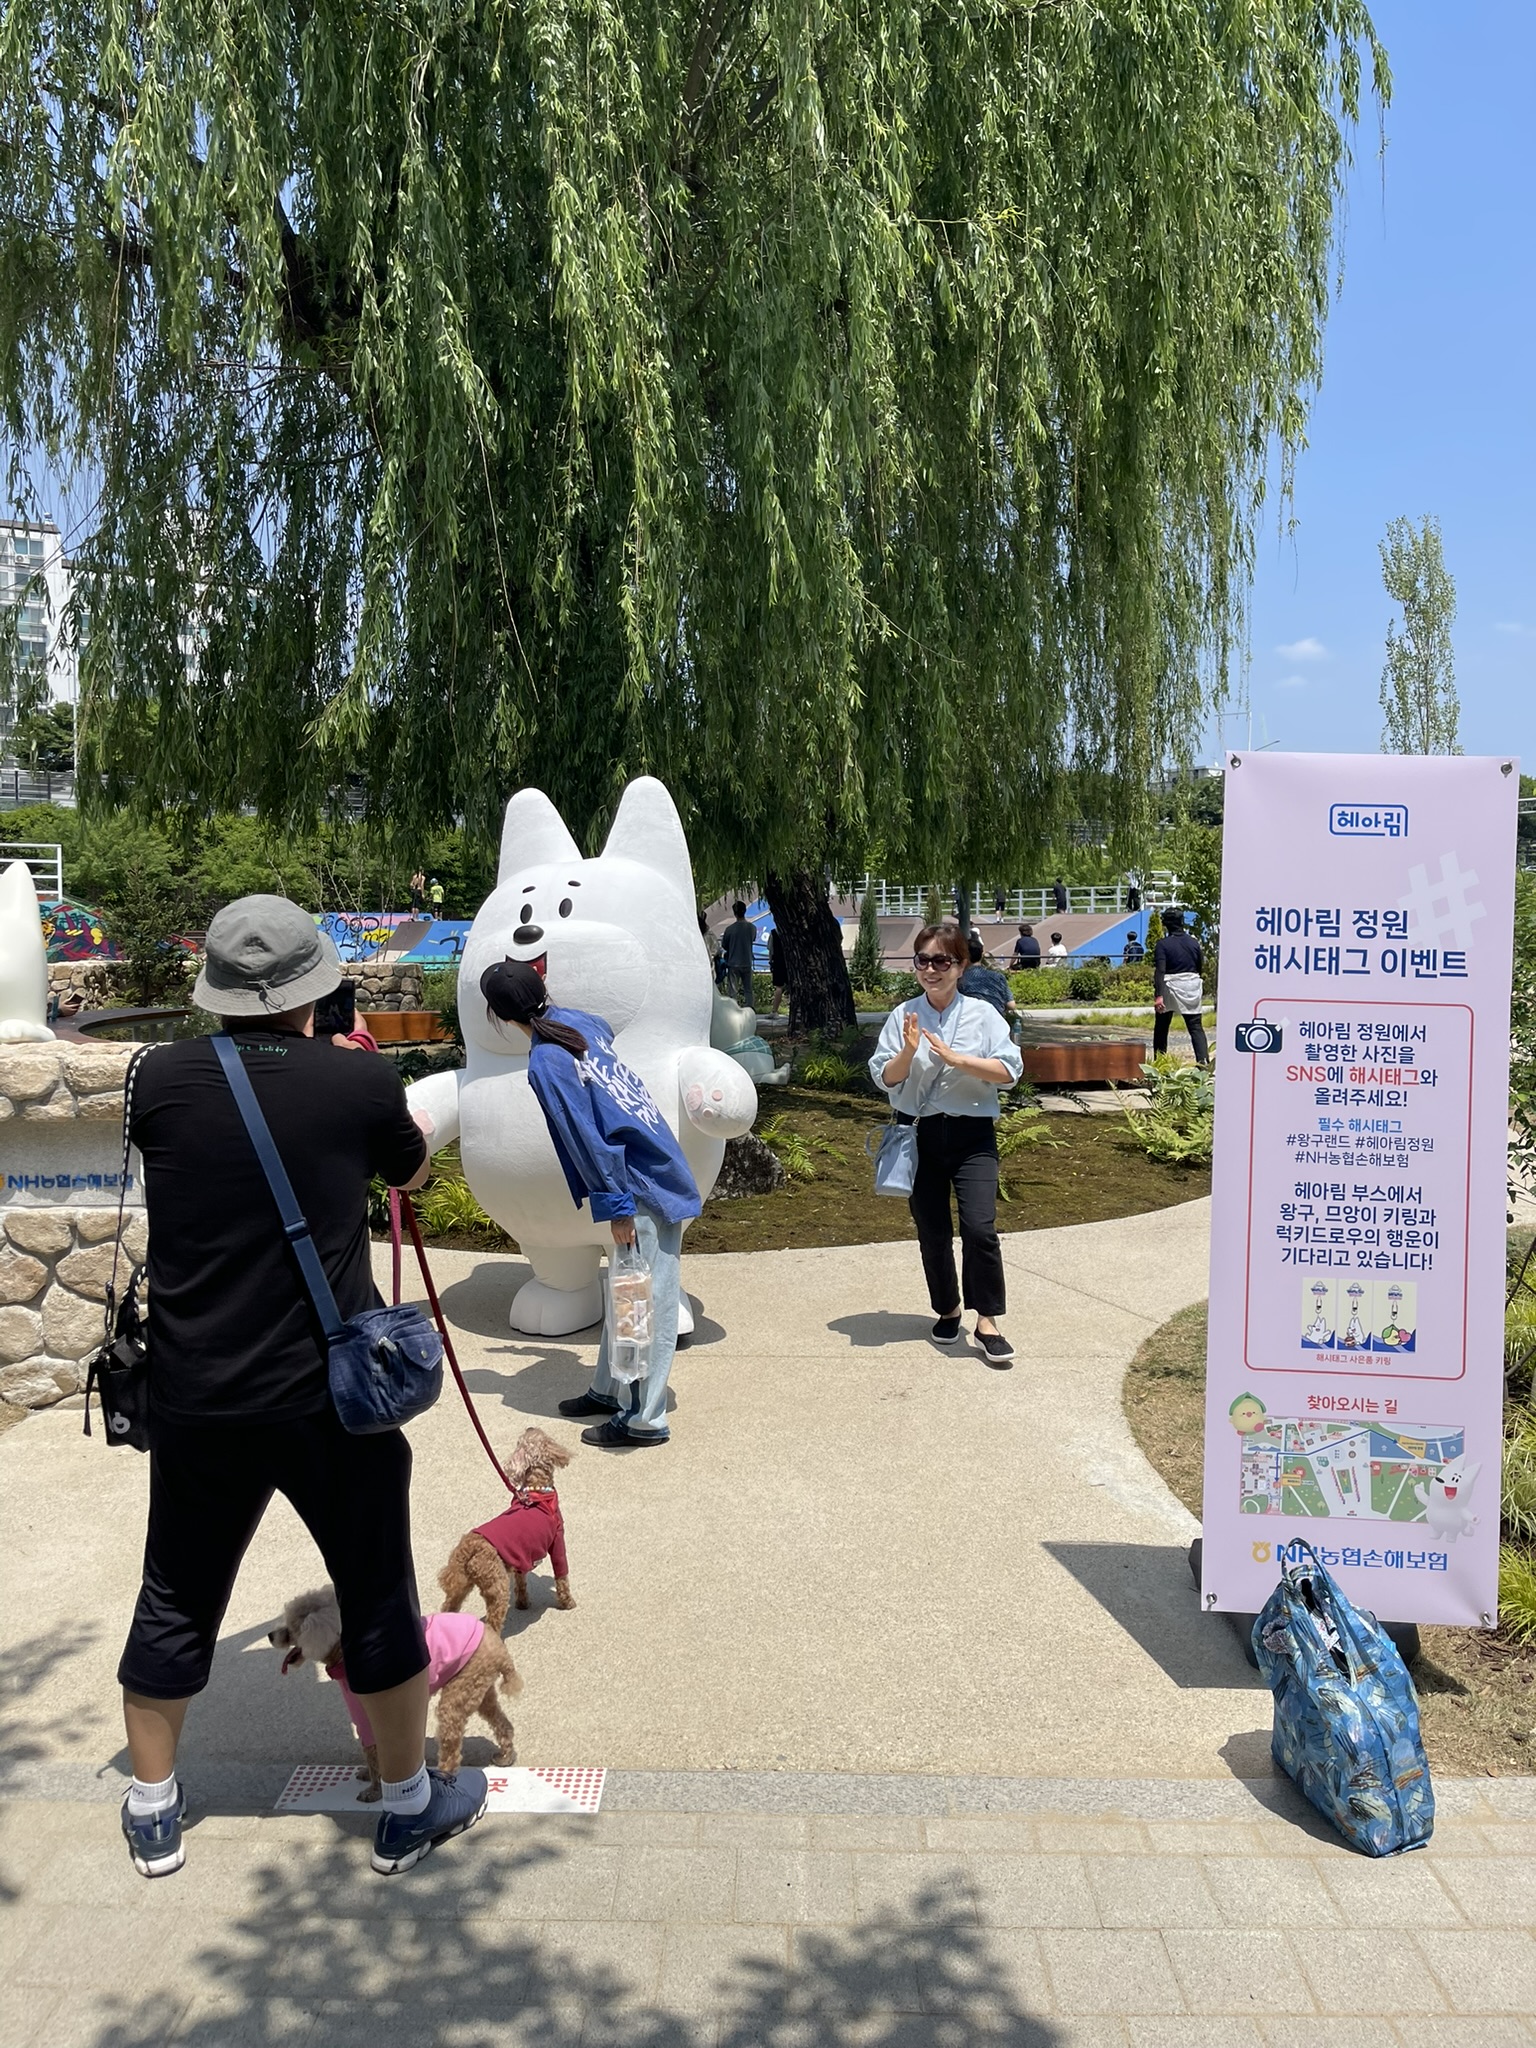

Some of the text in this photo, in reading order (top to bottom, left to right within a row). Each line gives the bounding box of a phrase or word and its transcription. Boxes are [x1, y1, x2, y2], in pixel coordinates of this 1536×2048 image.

[1337, 809, 1401, 837] 헤아림
[1255, 906, 1409, 940] 헤아림 정원
[1254, 944, 1469, 979] 해시태그 이벤트
[1299, 1021, 1427, 1043] 헤아림 정원에서
[1305, 1043, 1416, 1064] 촬영한 사진을
[1286, 1065, 1439, 1087] SNS에 해시태그와
[1314, 1087, 1408, 1107] 올려주세요!
[1318, 1117, 1403, 1134] 필수 해시태그
[1286, 1134, 1434, 1152] #왕구랜드 #헤아림정원
[1294, 1151, 1409, 1168] #NH농협손해보험
[1294, 1182, 1422, 1204] 헤아림 부스에서
[1280, 1203, 1437, 1227] 왕구, 므앙이 키링과
[1276, 1225, 1439, 1249] 럭키드로우의 행운이
[1281, 1247, 1433, 1271] 기다리고 있습니다!
[1316, 1353, 1348, 1364] 해시태그
[1375, 1356, 1391, 1366] 키링
[1307, 1395, 1397, 1414] 찾아오시는 길
[1276, 1544, 1448, 1571] NH농협손해보험
